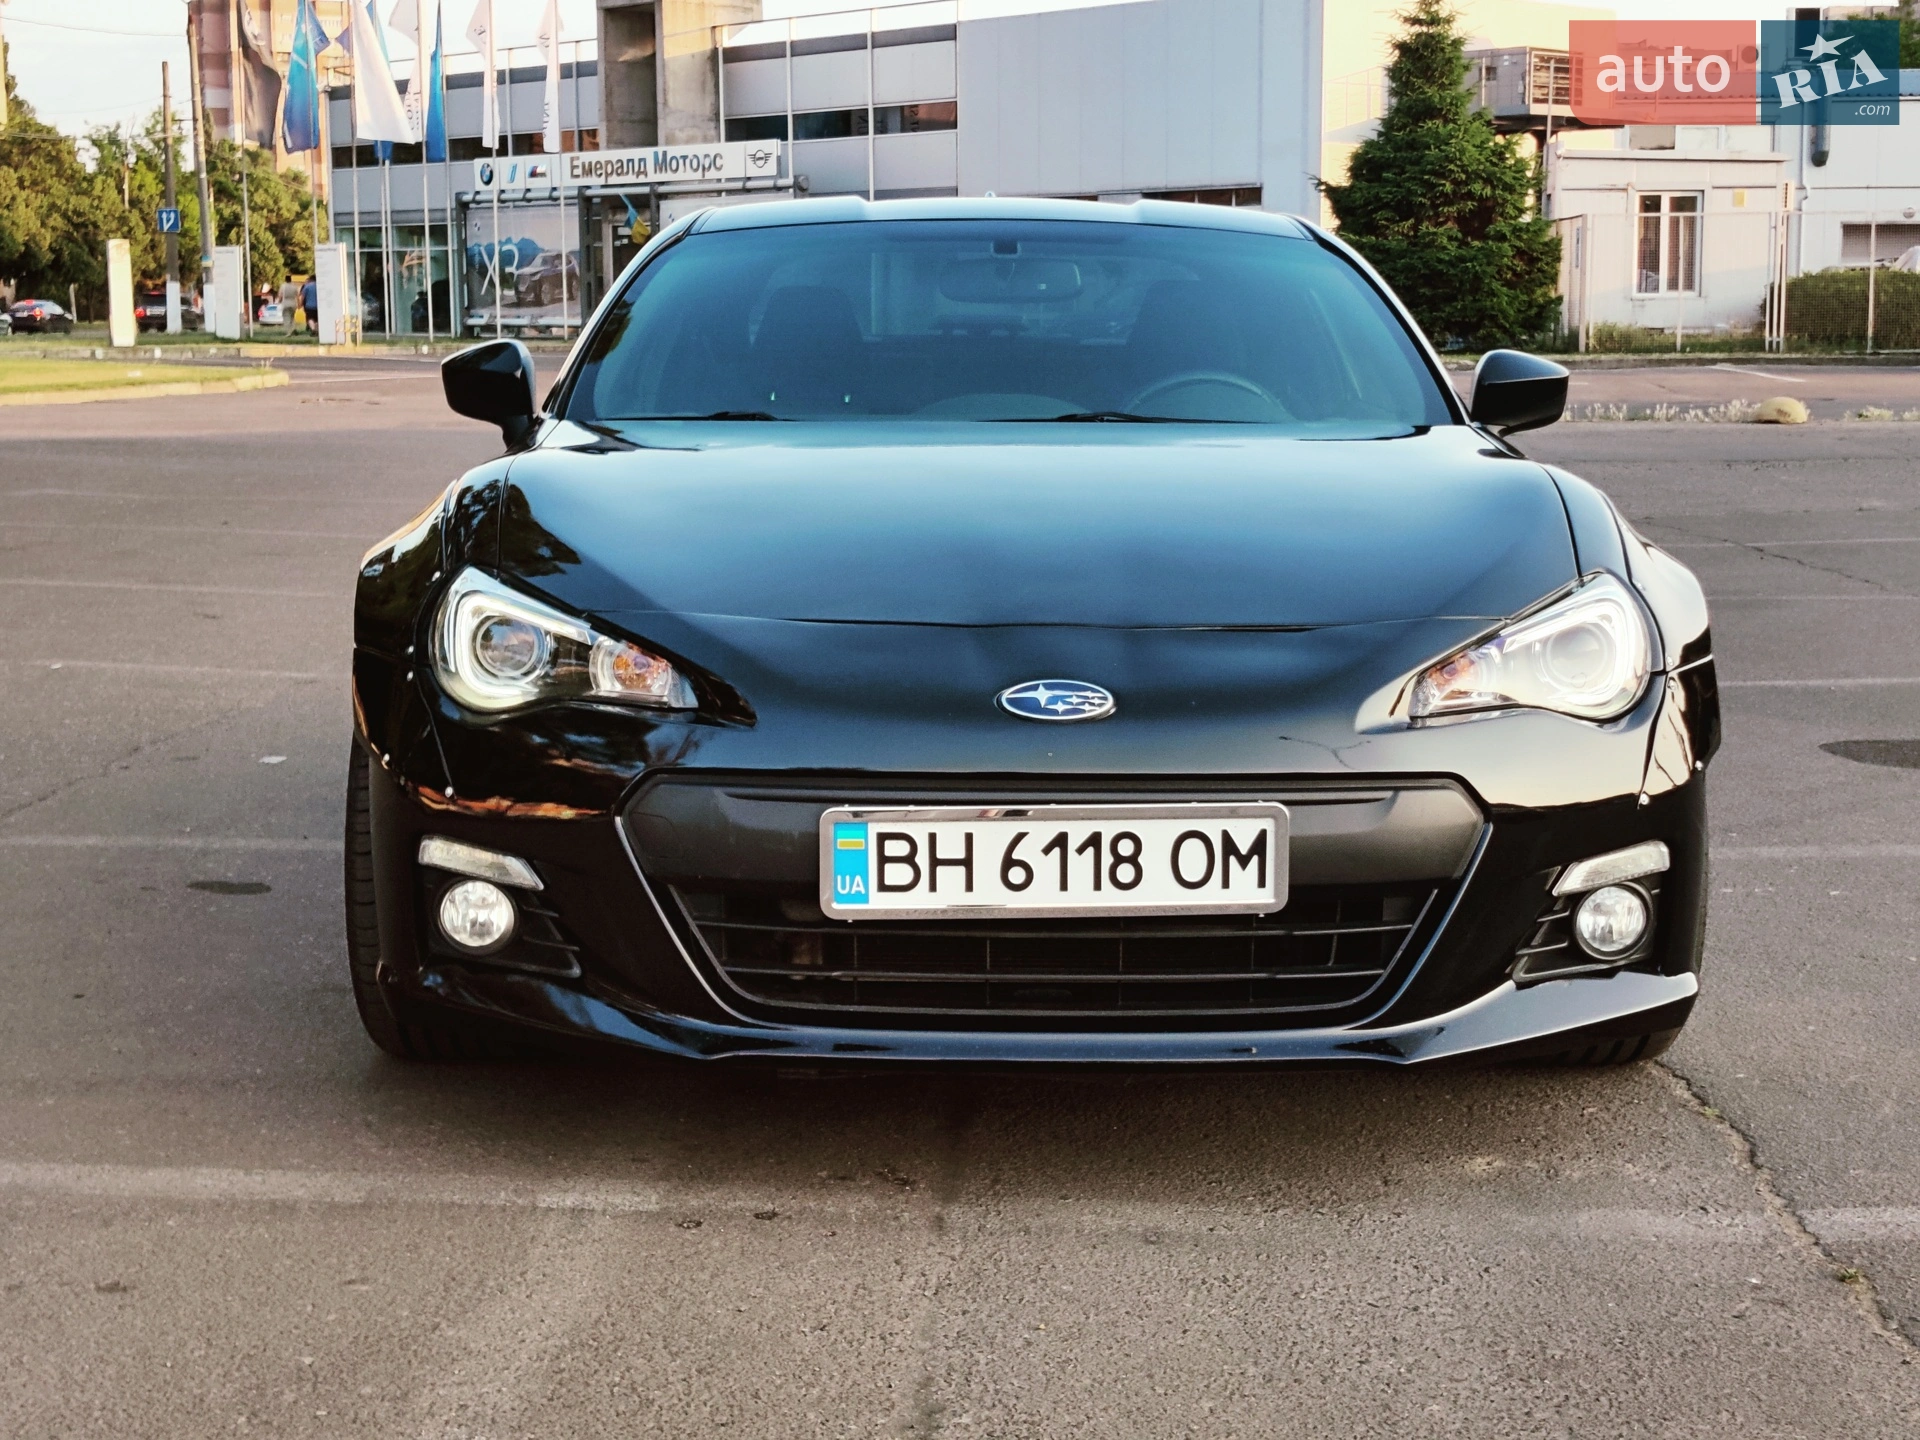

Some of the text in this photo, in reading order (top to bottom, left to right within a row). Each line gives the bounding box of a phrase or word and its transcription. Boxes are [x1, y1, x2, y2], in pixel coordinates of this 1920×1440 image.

[569, 156, 648, 184] Емералд
[653, 150, 724, 179] Моторс
[876, 827, 1268, 893] BH 6118 OM
[837, 874, 866, 895] UA
